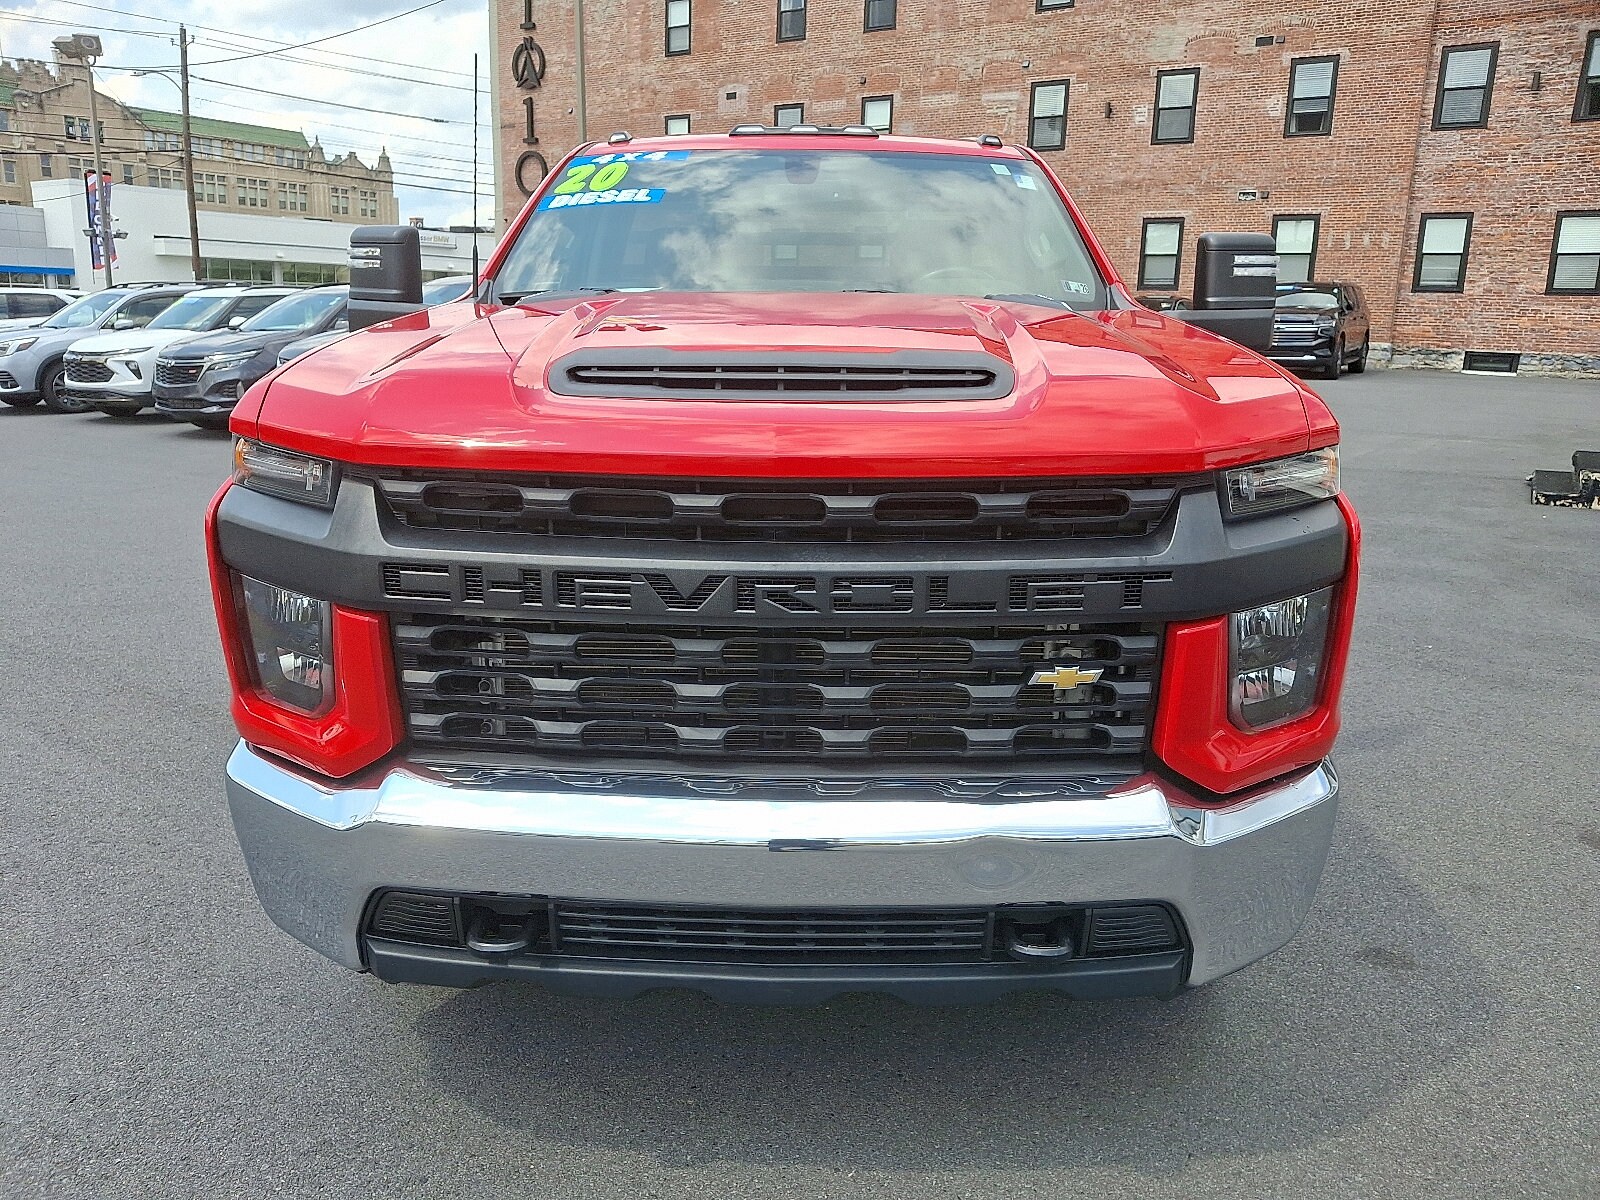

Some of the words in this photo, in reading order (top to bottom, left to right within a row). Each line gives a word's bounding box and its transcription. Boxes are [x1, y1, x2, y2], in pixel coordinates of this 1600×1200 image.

[554, 162, 629, 195] 20
[547, 188, 652, 209] DIESEL
[382, 561, 1173, 616] CHEVROLET
